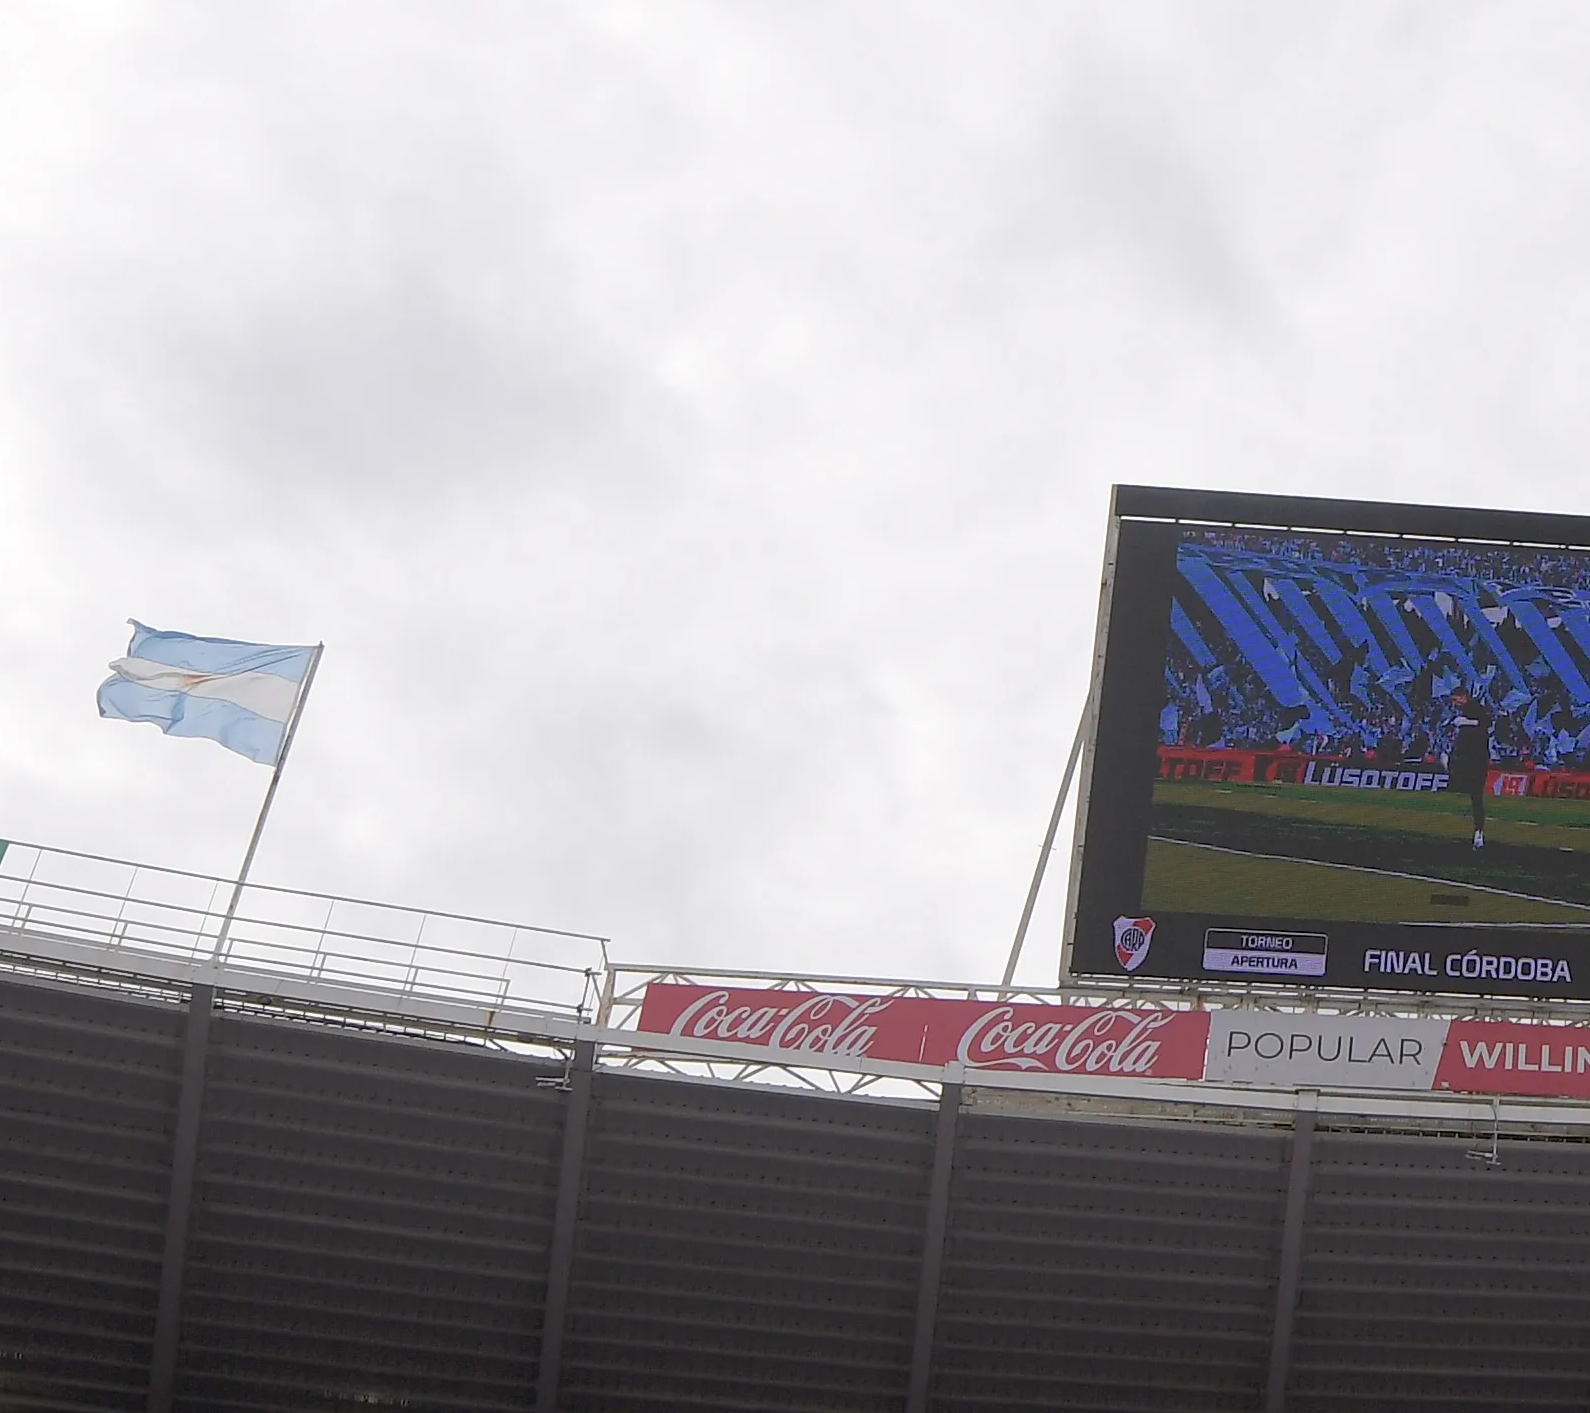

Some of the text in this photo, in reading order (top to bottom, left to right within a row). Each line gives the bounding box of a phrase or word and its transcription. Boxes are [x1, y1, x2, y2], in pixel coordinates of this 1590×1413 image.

[1240, 933, 1294, 950] TORNEO
[1230, 954, 1299, 970] APERTURA
[1363, 948, 1573, 983] FINAL CÓRDOBA
[670, 990, 894, 1058] Coca-Cola
[957, 1005, 1177, 1075] Coca-Cola
[1226, 1029, 1425, 1066] POPULAR
